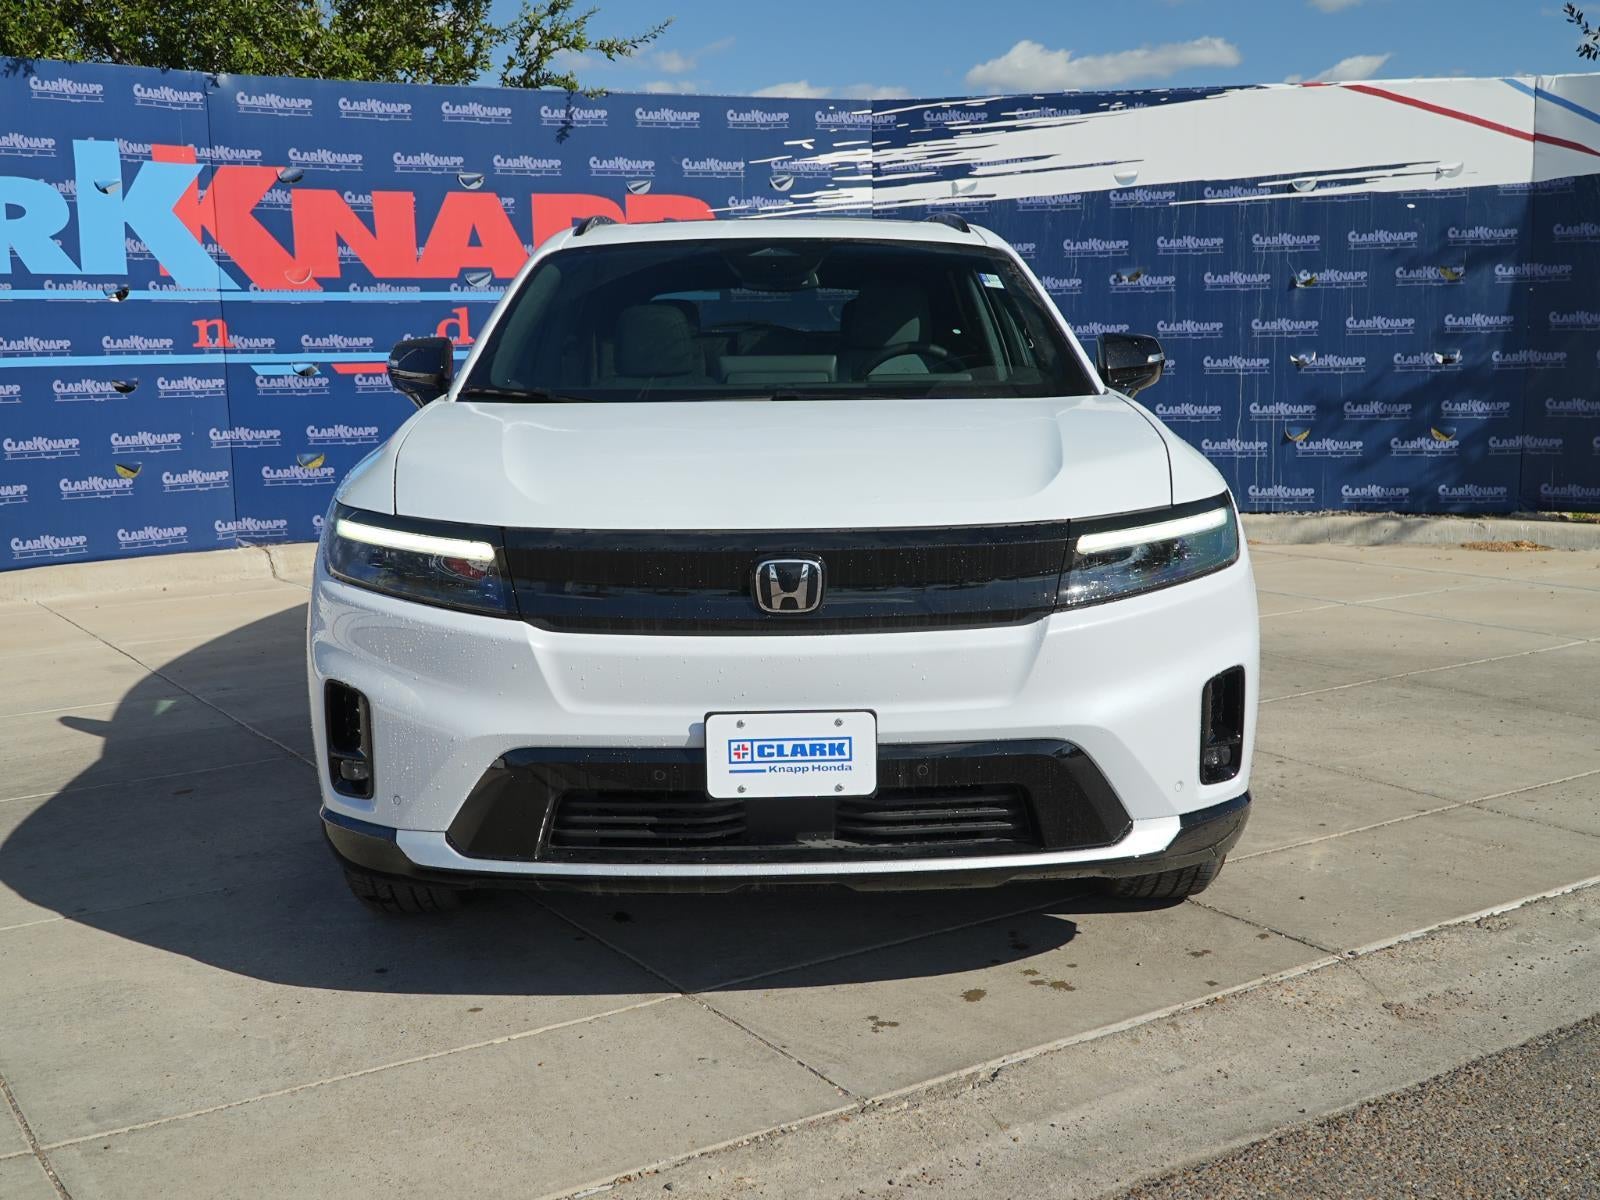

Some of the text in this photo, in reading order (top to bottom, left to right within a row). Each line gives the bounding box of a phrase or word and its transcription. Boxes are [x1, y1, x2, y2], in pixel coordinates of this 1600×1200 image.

[757, 742, 847, 758] CLARK
[768, 763, 852, 775] Knapp Honda
